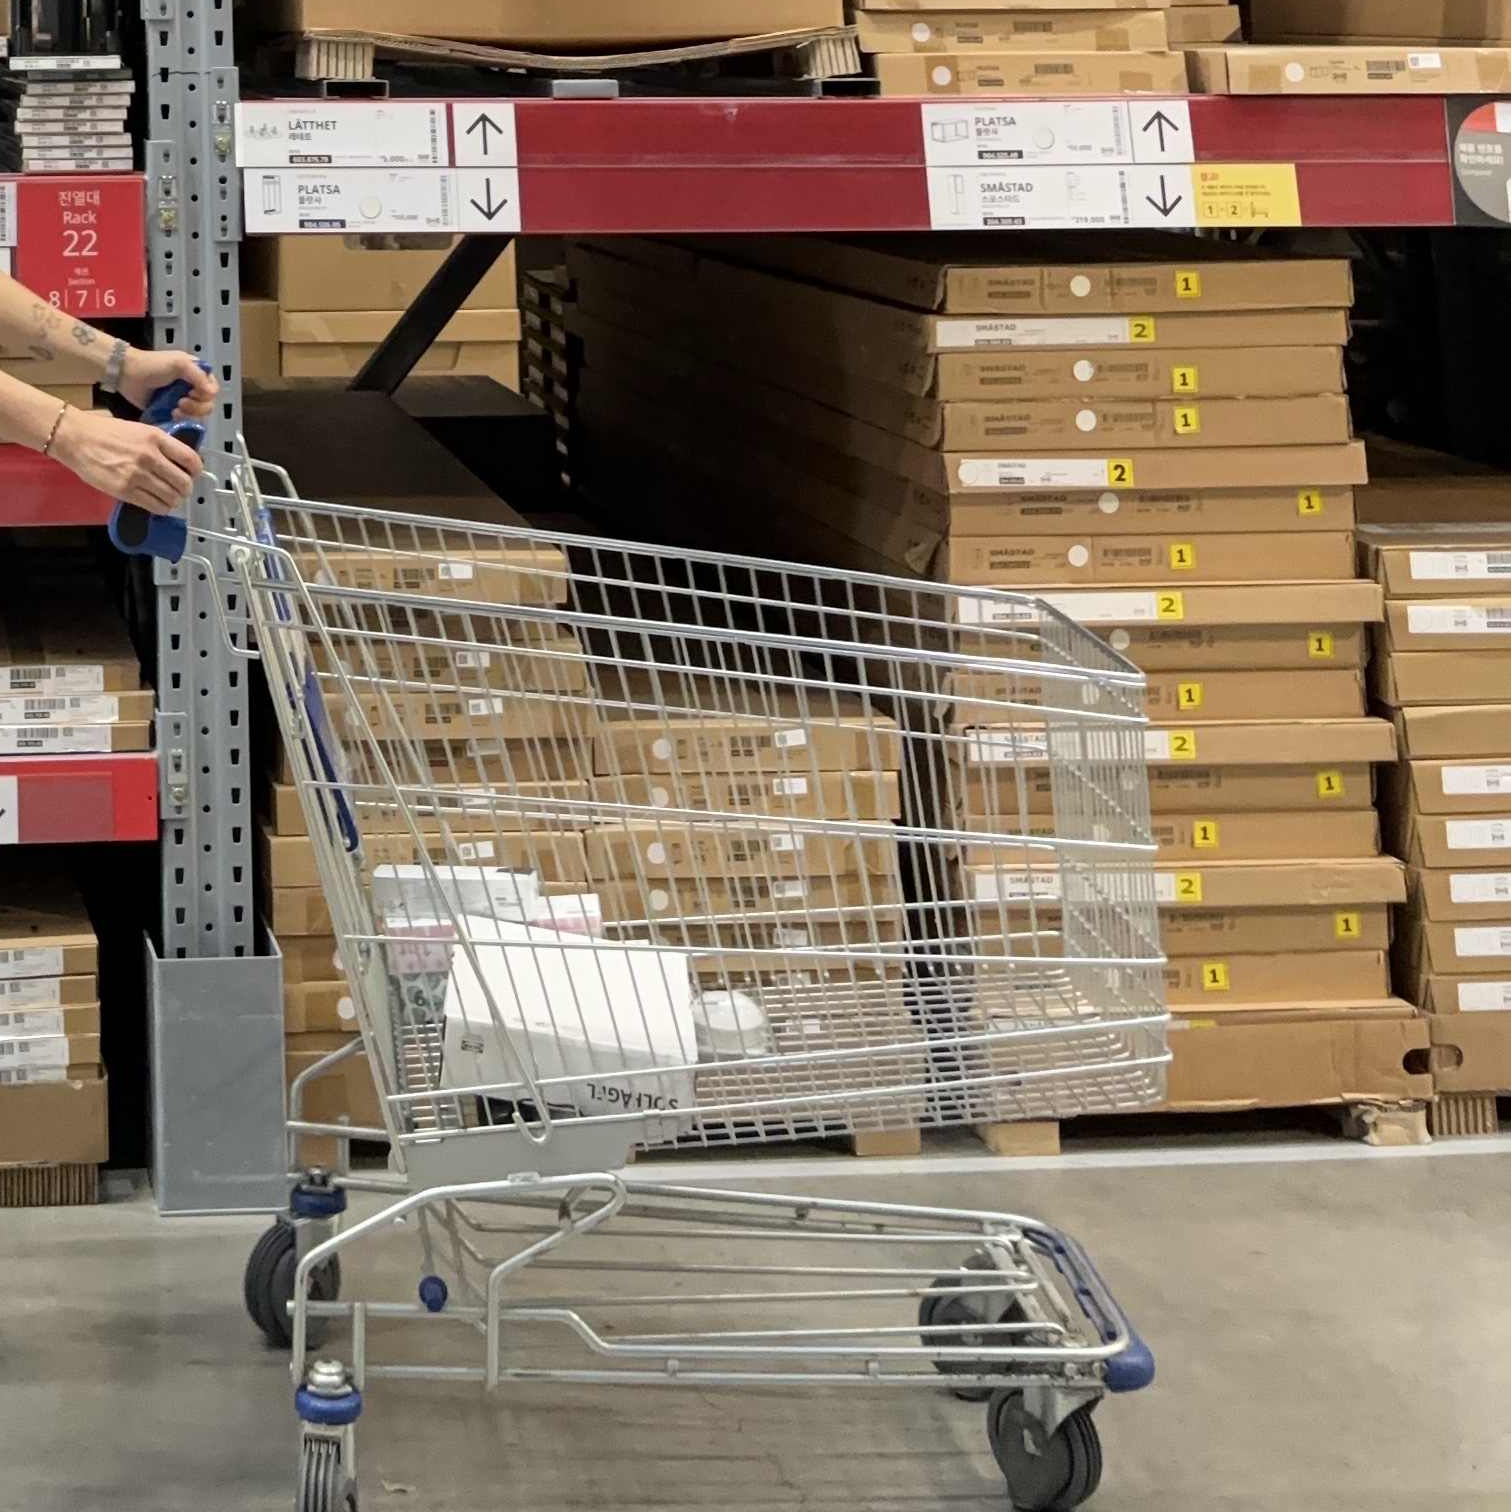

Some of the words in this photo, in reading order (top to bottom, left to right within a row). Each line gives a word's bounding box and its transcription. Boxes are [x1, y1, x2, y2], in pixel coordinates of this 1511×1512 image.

[288, 118, 337, 130] LÄTTHET
[975, 116, 1017, 126] PLATSA
[298, 184, 341, 195] PLATSA
[980, 182, 1033, 193] SMÅSTAD
[58, 190, 101, 206] 진열대
[1207, 205, 1213, 214] 1
[1231, 205, 1237, 215] 2
[63, 211, 97, 226] Rack
[62, 229, 99, 257] 22
[1182, 277, 1191, 291] 1
[48, 291, 61, 308] 8
[76, 290, 87, 308] 7
[103, 290, 116, 308] 6
[1133, 324, 1147, 338] 2
[1179, 373, 1188, 386] 1
[1181, 413, 1190, 427] 1
[1113, 465, 1126, 481] 2
[1304, 495, 1313, 509] 1
[1177, 549, 1185, 562] 1
[1161, 598, 1174, 612] 2
[1315, 637, 1325, 651] 1
[1186, 688, 1194, 702] 1
[1174, 736, 1187, 751] 2
[1325, 776, 1335, 790] 1
[1201, 826, 1209, 840] 1
[1180, 879, 1193, 894] 2
[1342, 918, 1352, 932] 1
[1210, 969, 1220, 983] 1
